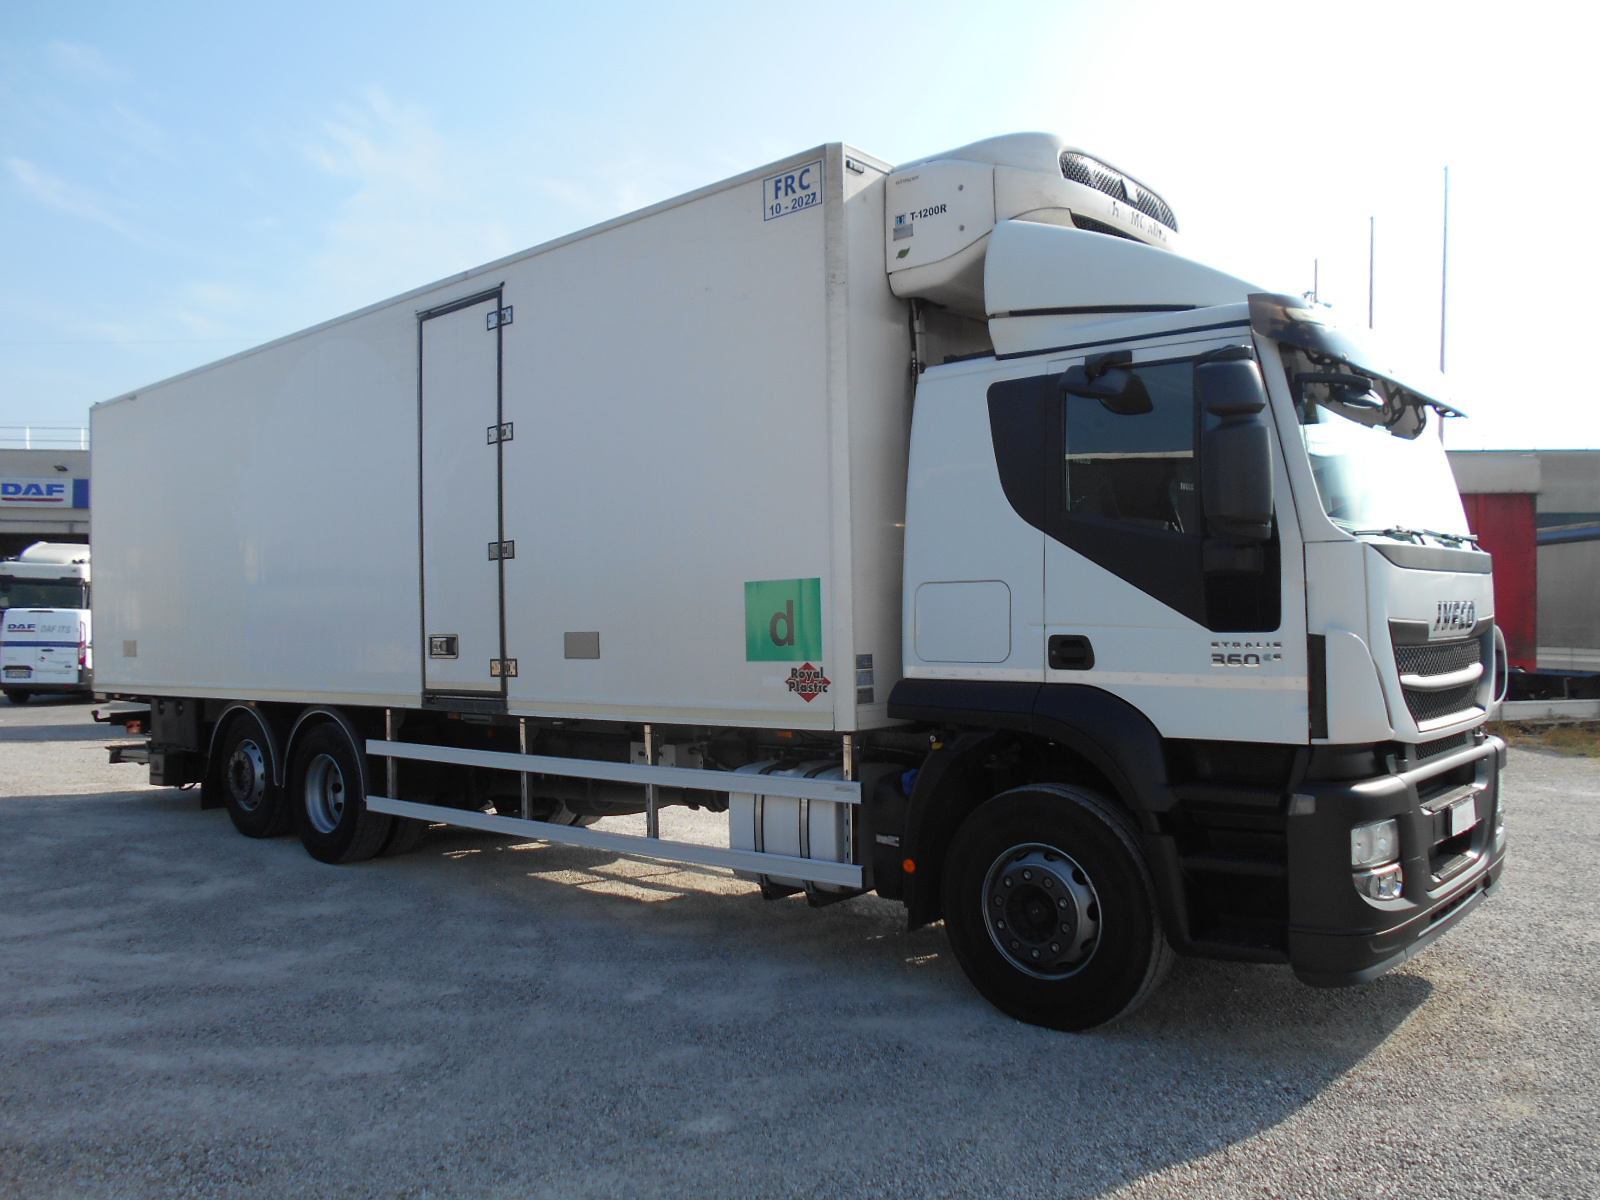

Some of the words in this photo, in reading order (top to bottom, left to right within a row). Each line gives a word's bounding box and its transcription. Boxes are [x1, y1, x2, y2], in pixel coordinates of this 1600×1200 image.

[774, 167, 810, 200] FRC
[769, 203, 781, 216] 10
[791, 192, 817, 210] 2027
[909, 203, 947, 221] T-1200R
[1, 483, 64, 496] DAF
[769, 599, 795, 647] d
[1433, 600, 1476, 631] IVECO
[1210, 641, 1282, 649] STRALIS
[1211, 653, 1260, 668] 360
[790, 666, 824, 682] Royal
[788, 680, 828, 693] Plastic
